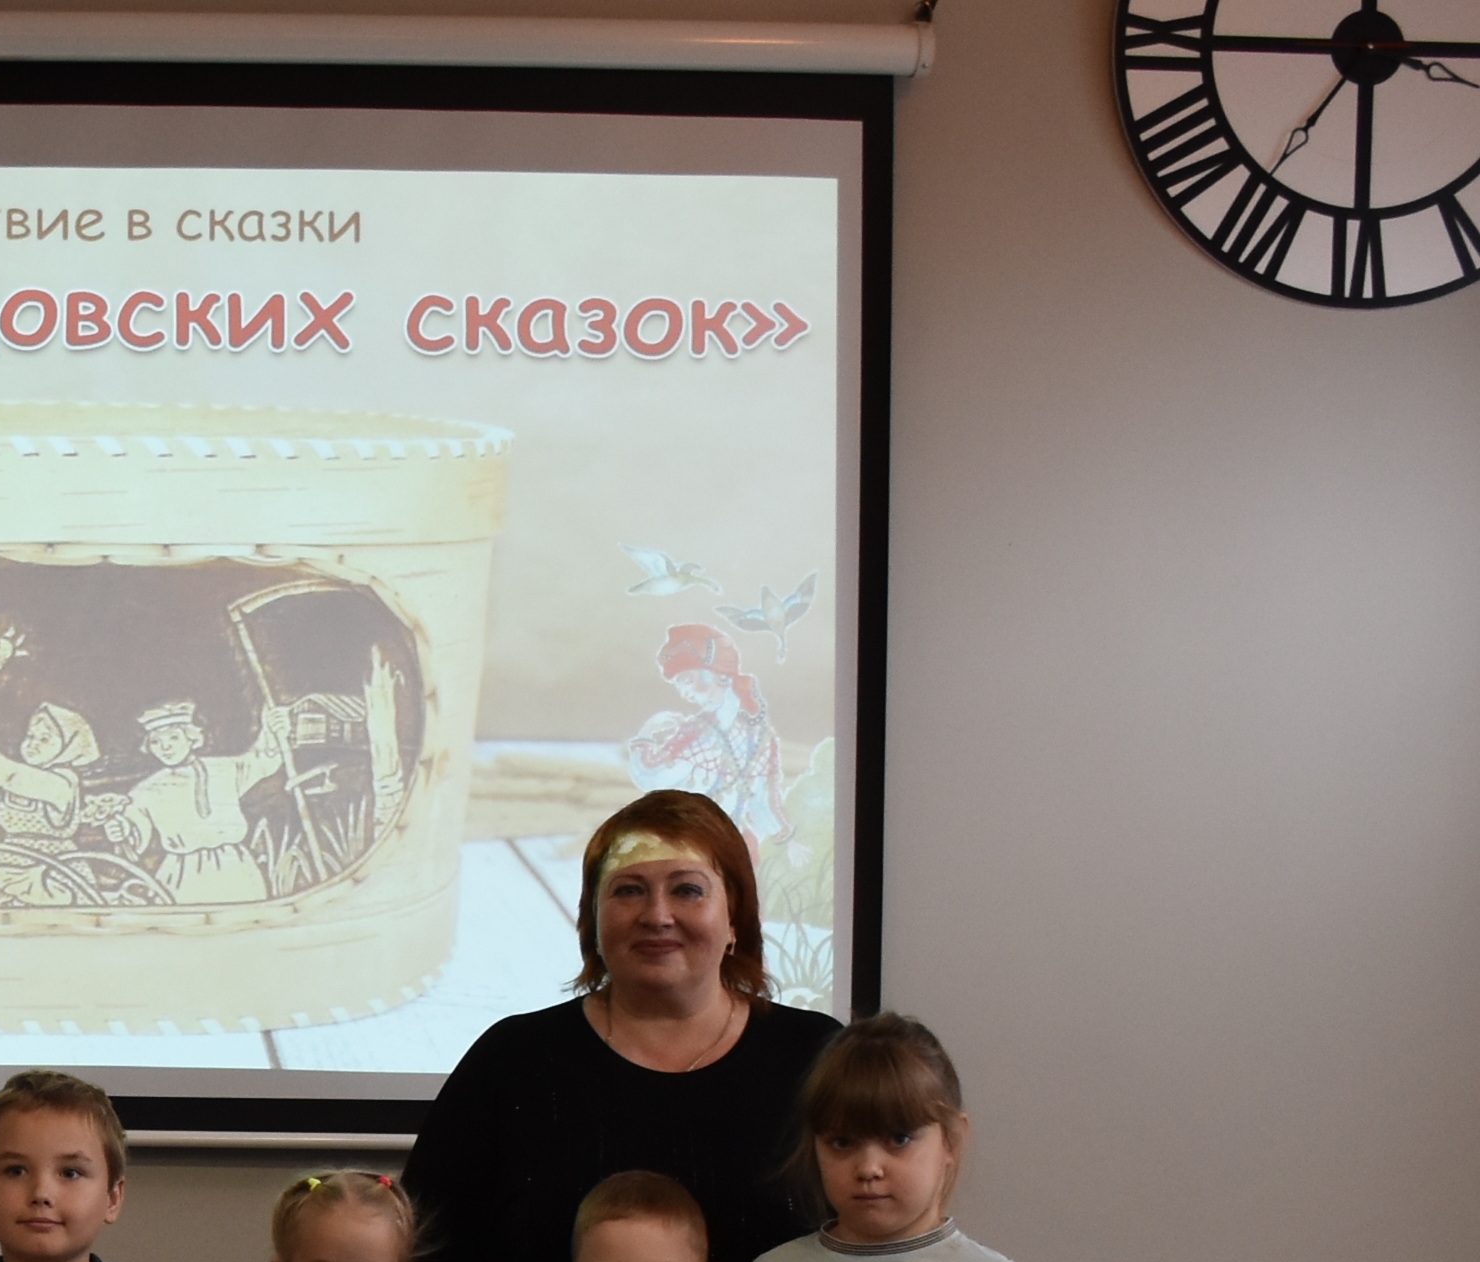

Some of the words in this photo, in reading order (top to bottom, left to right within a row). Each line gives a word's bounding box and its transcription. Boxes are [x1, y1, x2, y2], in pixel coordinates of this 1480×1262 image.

[127, 207, 153, 240] в
[175, 206, 362, 244] сказки
[405, 293, 810, 360] сказок»
